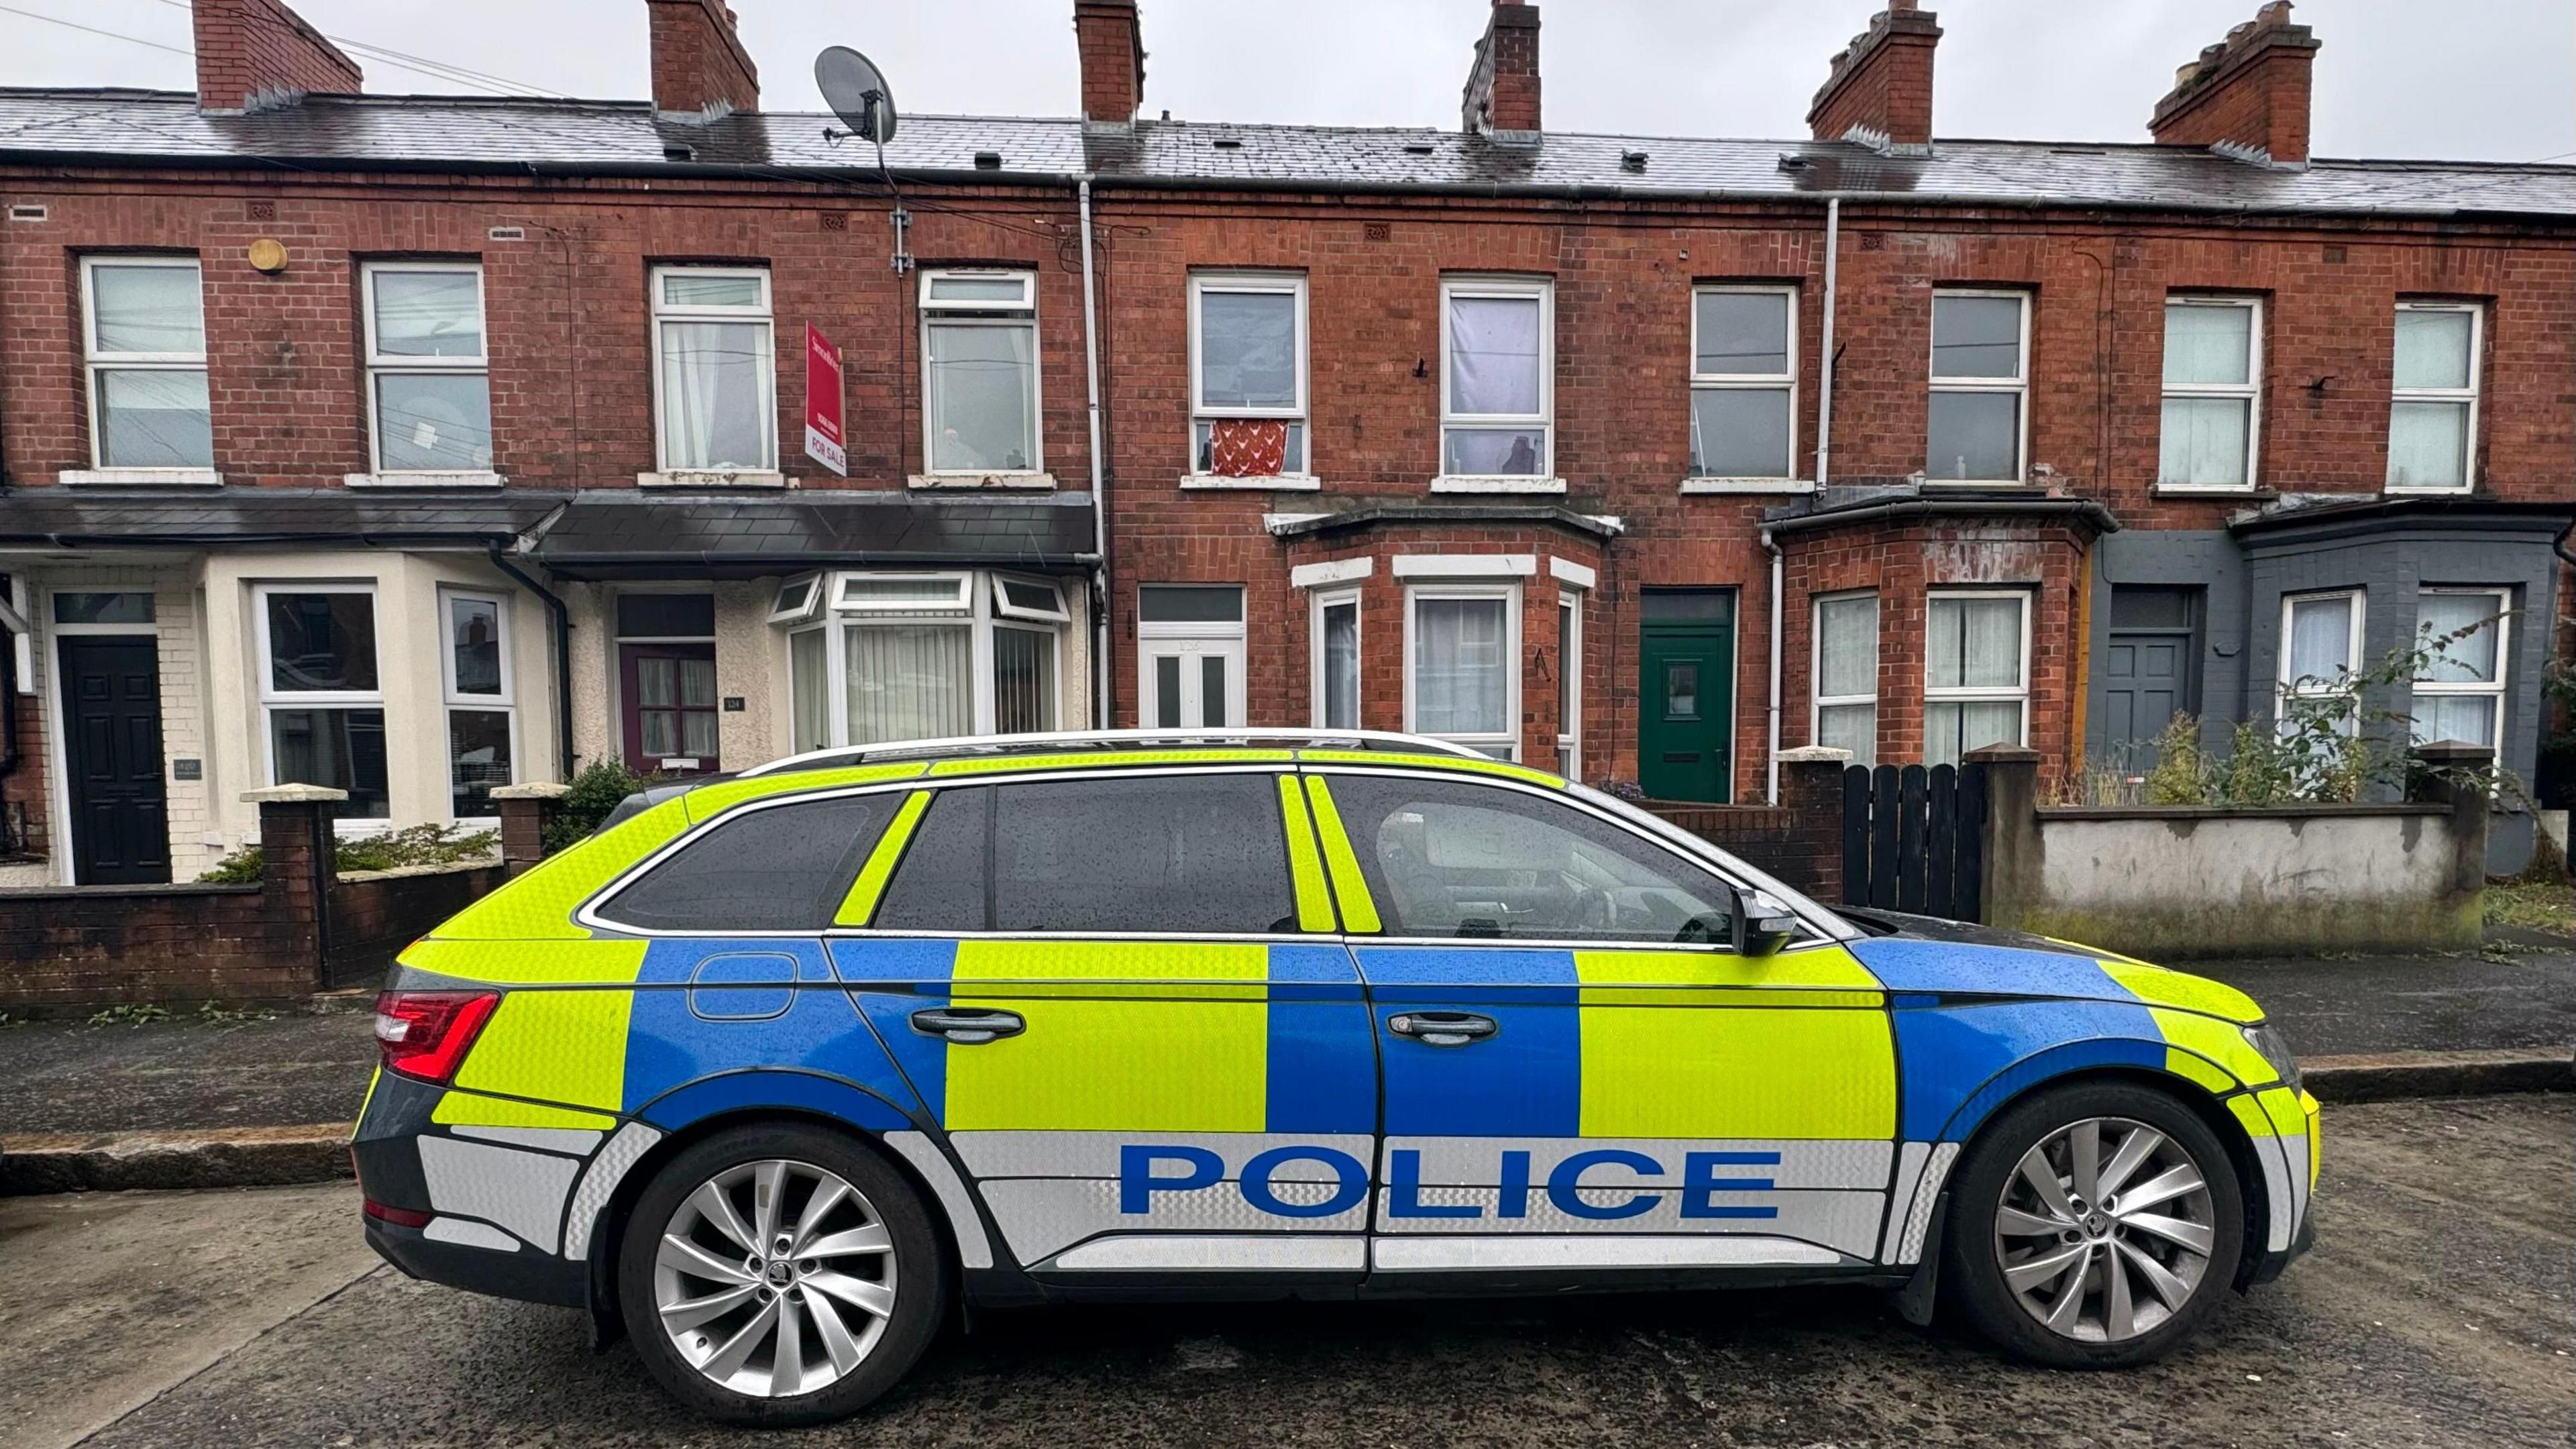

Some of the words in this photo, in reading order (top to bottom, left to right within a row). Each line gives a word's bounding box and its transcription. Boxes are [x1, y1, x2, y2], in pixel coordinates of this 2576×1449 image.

[812, 437, 825, 457] FOR
[826, 447, 845, 468] SALE
[1120, 1145, 1782, 1220] POLICE
